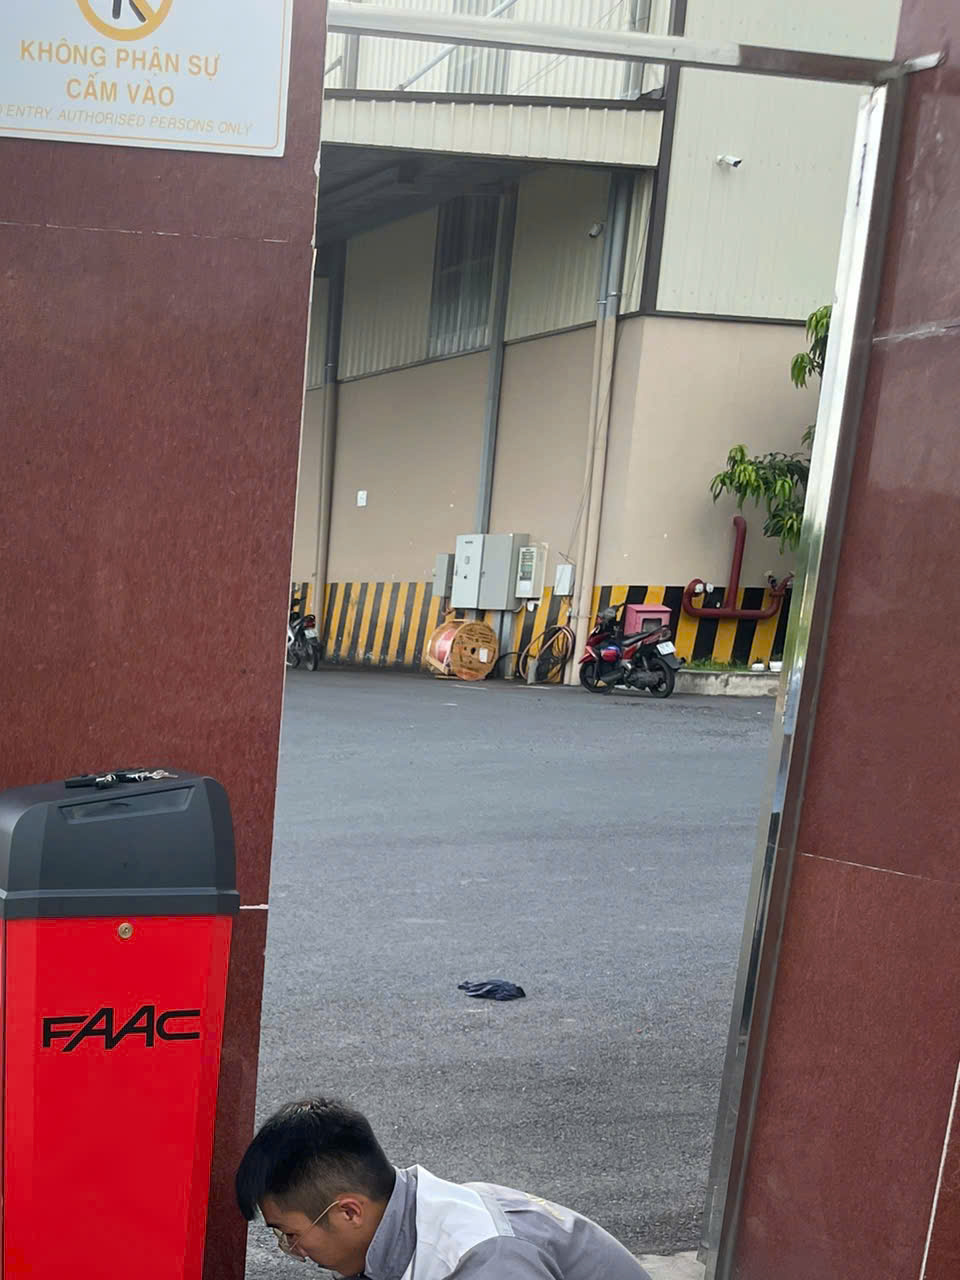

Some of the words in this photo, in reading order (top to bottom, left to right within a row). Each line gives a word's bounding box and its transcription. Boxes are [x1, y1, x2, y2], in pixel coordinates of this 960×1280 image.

[19, 37, 106, 68] KHÔNG
[188, 53, 221, 81] SỰ
[65, 72, 118, 103] CẤM
[127, 80, 175, 106] VÀO
[57, 109, 145, 128] AUTHORISED
[149, 115, 215, 133] PERSONS
[217, 120, 254, 136] ONLY
[41, 1004, 201, 1052] FAAC
